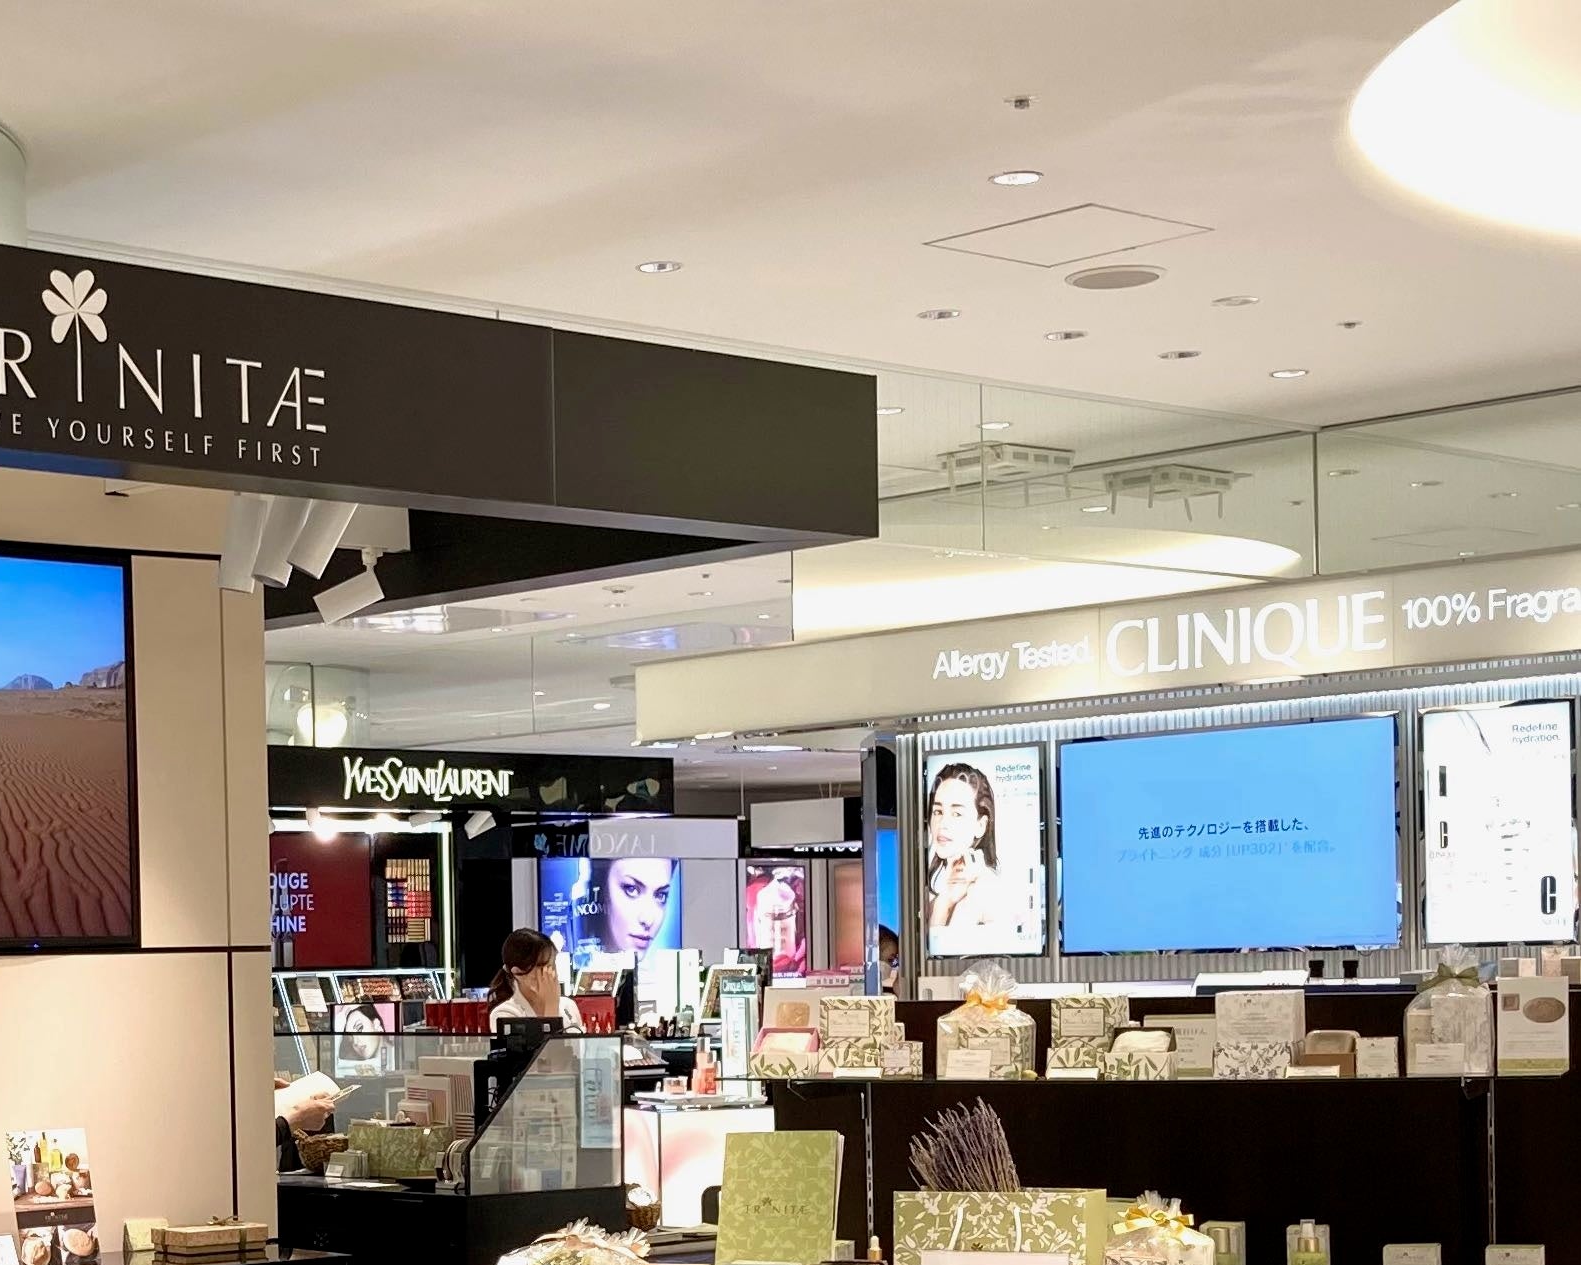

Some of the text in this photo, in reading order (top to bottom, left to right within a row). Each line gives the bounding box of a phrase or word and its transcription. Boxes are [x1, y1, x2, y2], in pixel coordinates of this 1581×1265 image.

[47, 417, 214, 456] YOURSELF
[238, 439, 321, 467] FIRST
[932, 649, 1010, 681] Allergy
[1106, 591, 1387, 678] CLINIQUE
[1401, 591, 1482, 630] 100%
[1511, 722, 1558, 733] Redefine
[1138, 817, 1310, 841] 先進のテクノロジーを搭載した、
